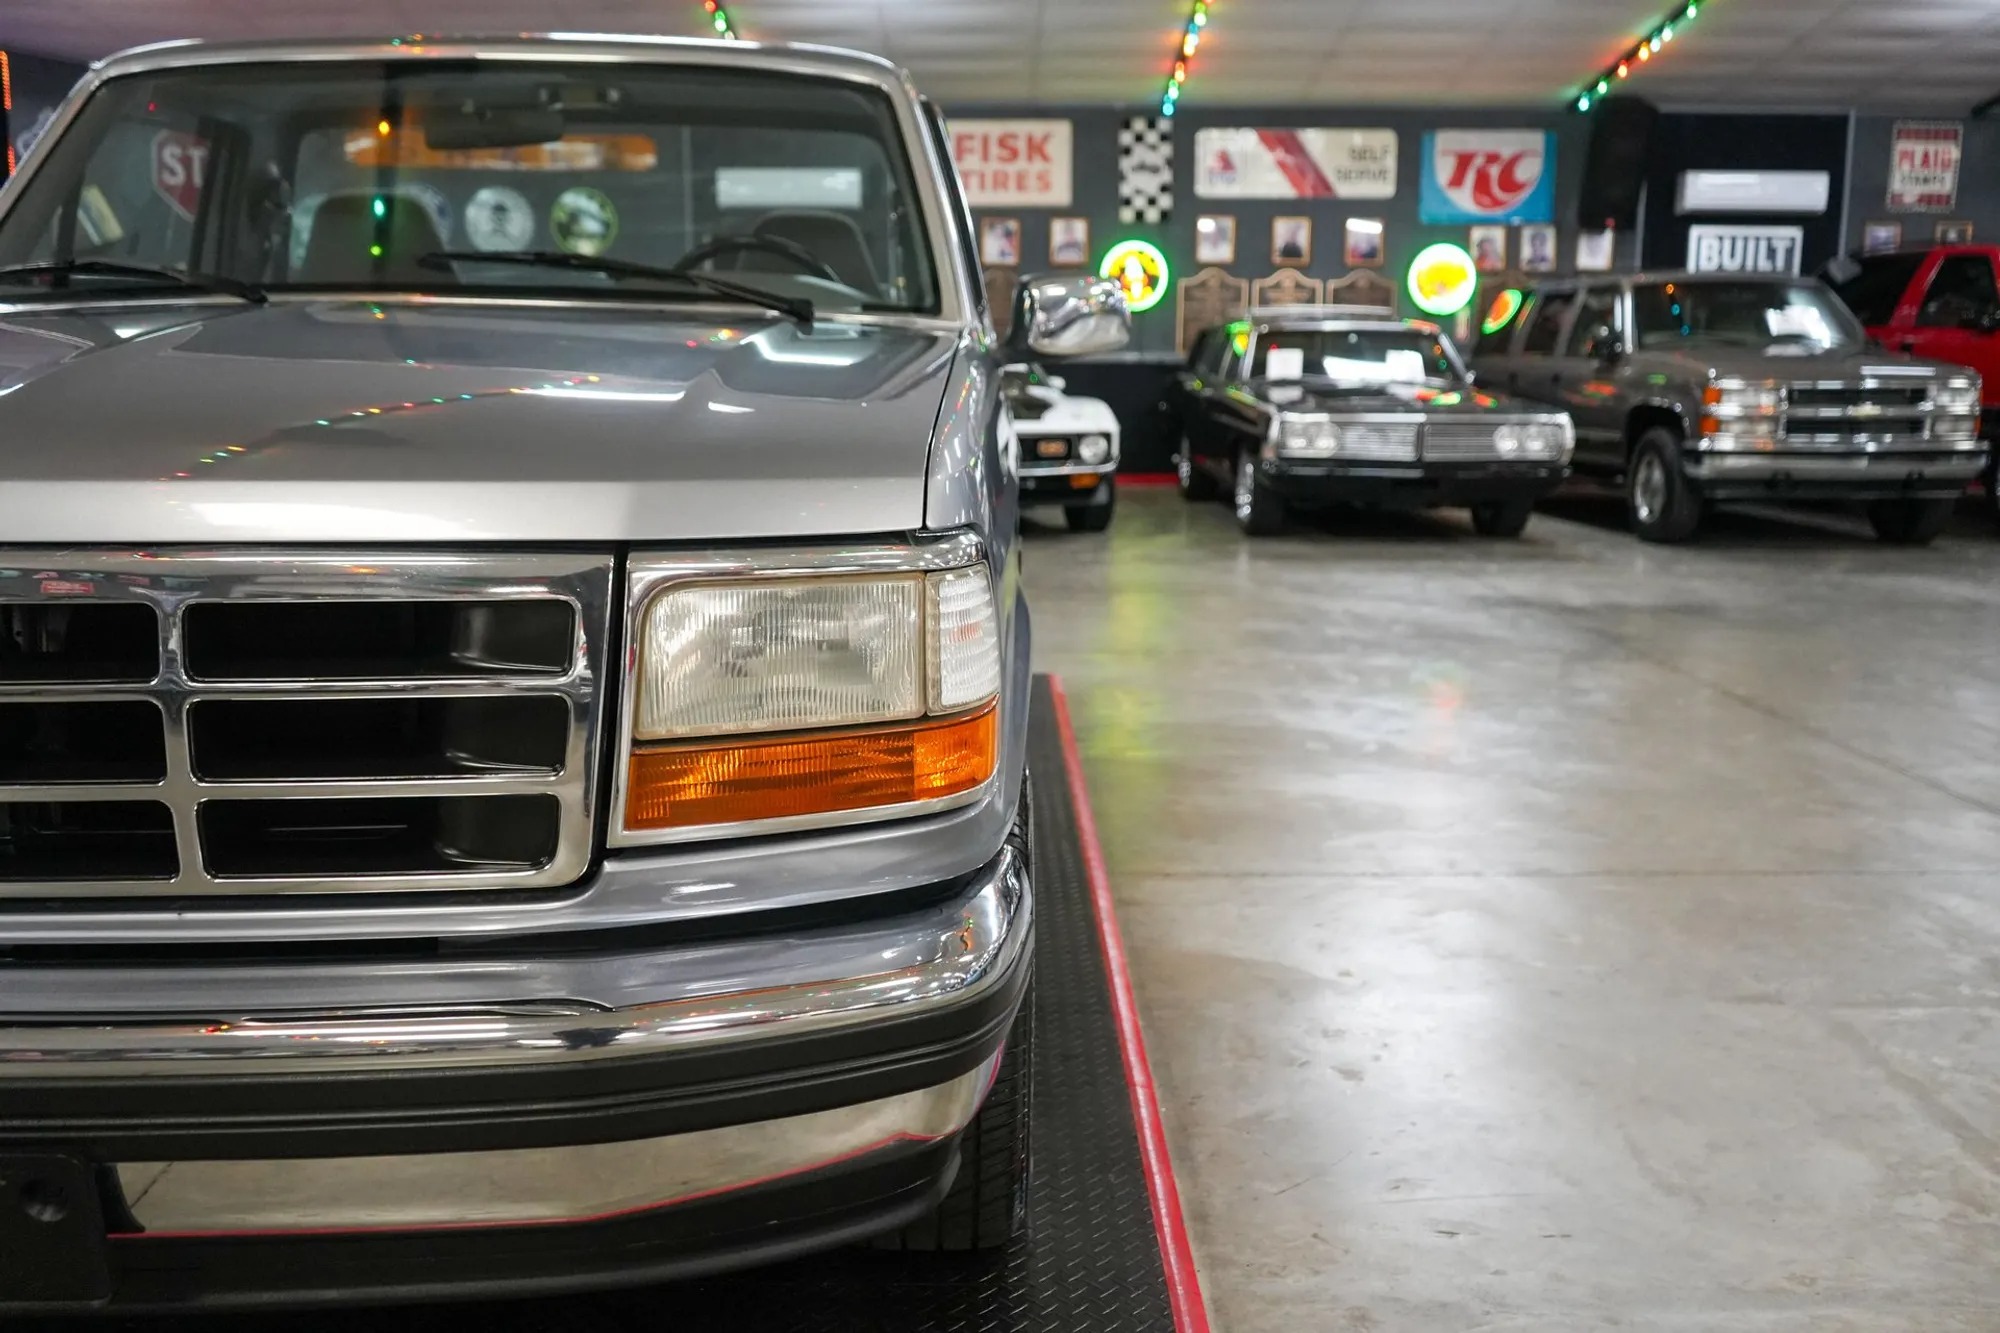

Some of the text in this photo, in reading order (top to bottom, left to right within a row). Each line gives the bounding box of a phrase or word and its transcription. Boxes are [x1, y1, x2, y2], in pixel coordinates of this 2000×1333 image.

[161, 144, 209, 188] ST
[955, 131, 1054, 164] FISK
[960, 168, 1053, 193] TIRES
[1440, 149, 1544, 209] RC
[1699, 236, 1794, 273] BUILT
